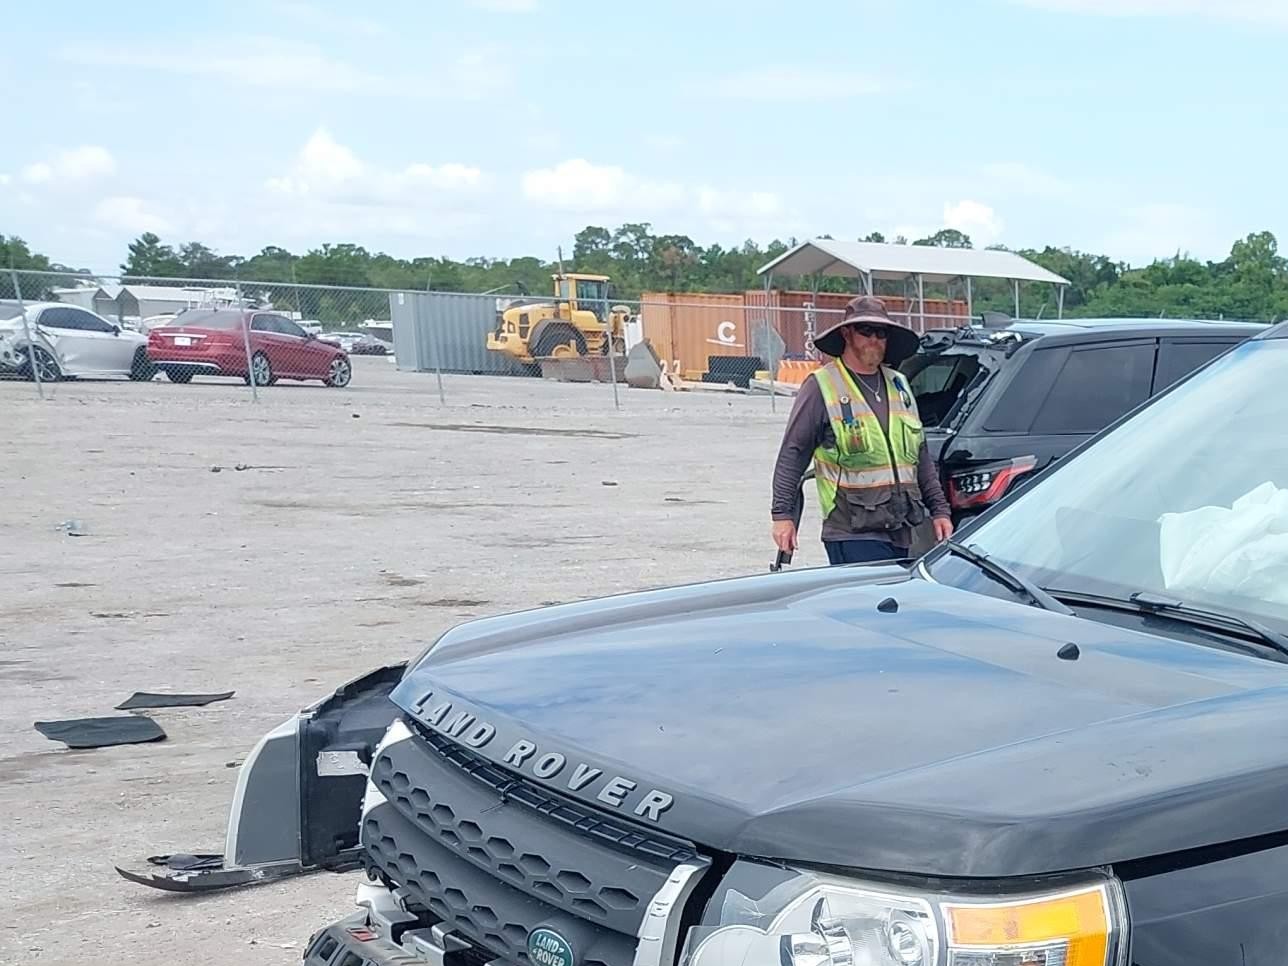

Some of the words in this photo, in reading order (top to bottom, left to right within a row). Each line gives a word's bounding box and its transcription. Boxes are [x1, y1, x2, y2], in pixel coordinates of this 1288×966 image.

[718, 321, 736, 343] C
[409, 690, 498, 749] LAND
[503, 739, 675, 822] ROVER
[535, 934, 560, 953] LAND
